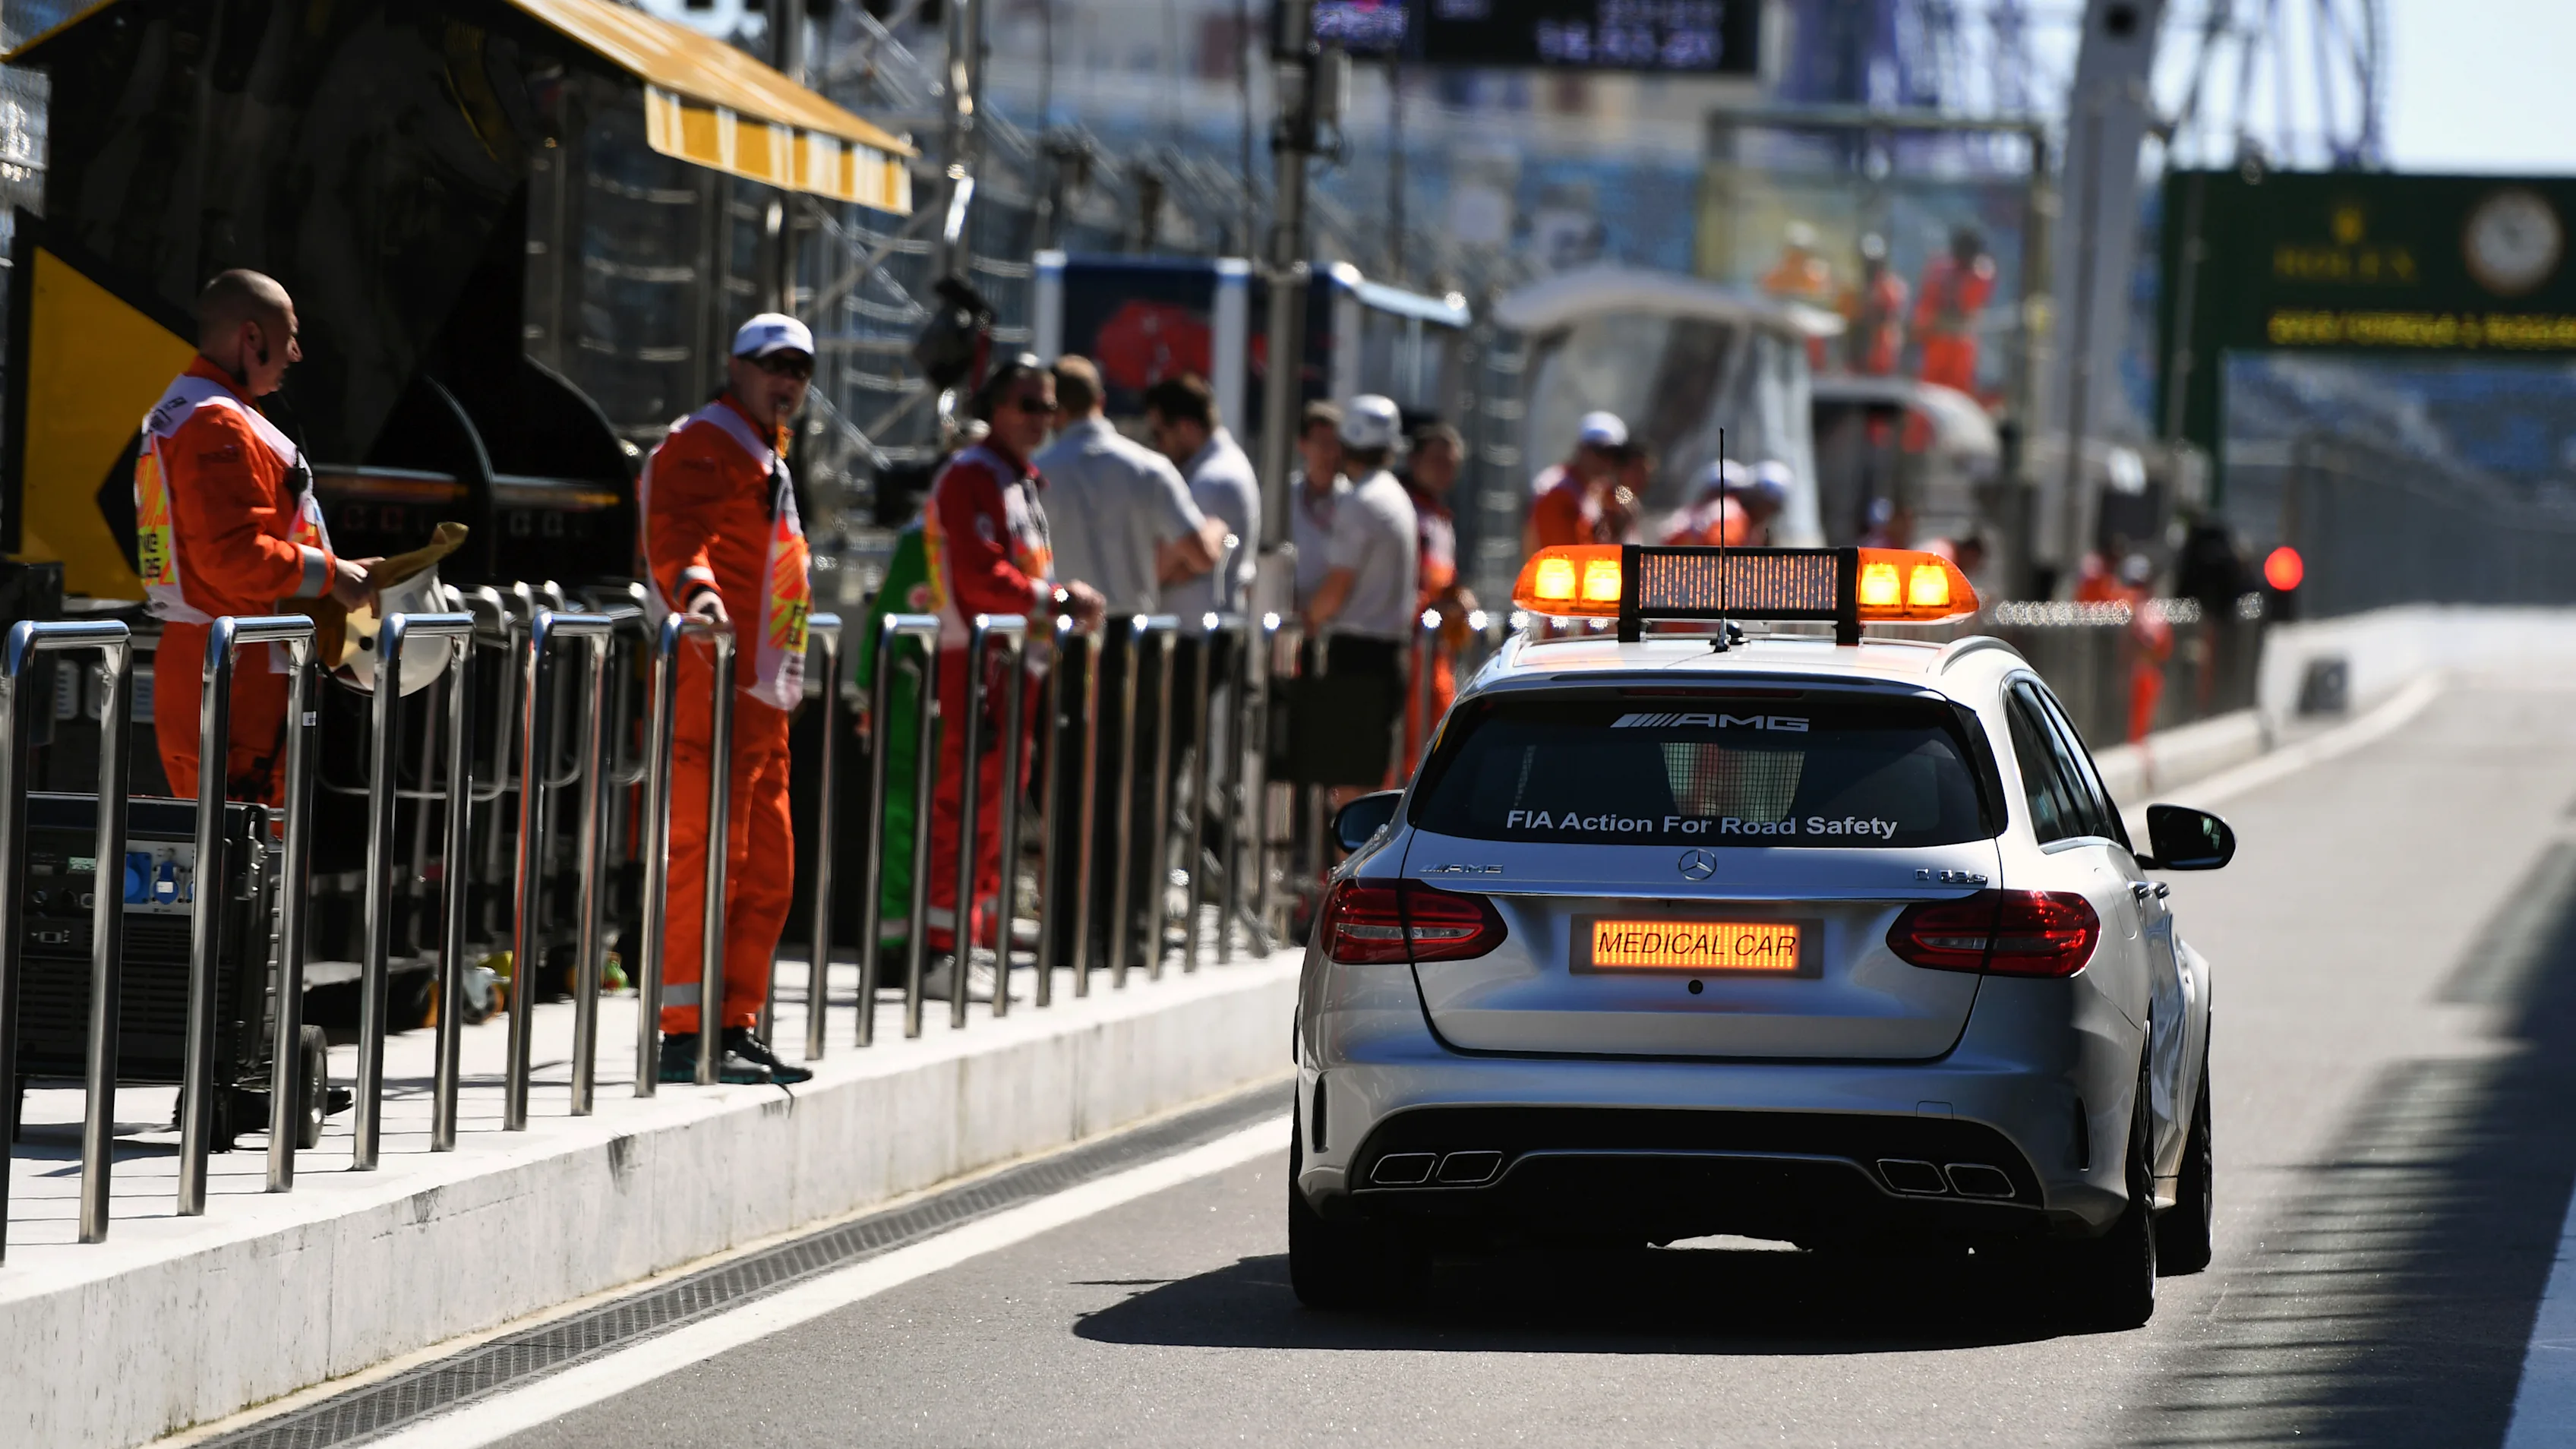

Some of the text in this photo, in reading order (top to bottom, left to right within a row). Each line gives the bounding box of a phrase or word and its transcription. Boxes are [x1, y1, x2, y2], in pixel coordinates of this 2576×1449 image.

[1669, 712, 1810, 732] AMG
[1506, 810, 1898, 840] FIA Action For Road Safety
[1444, 863, 1504, 874] AMG
[1598, 931, 1797, 957] MEDICAL CAR
